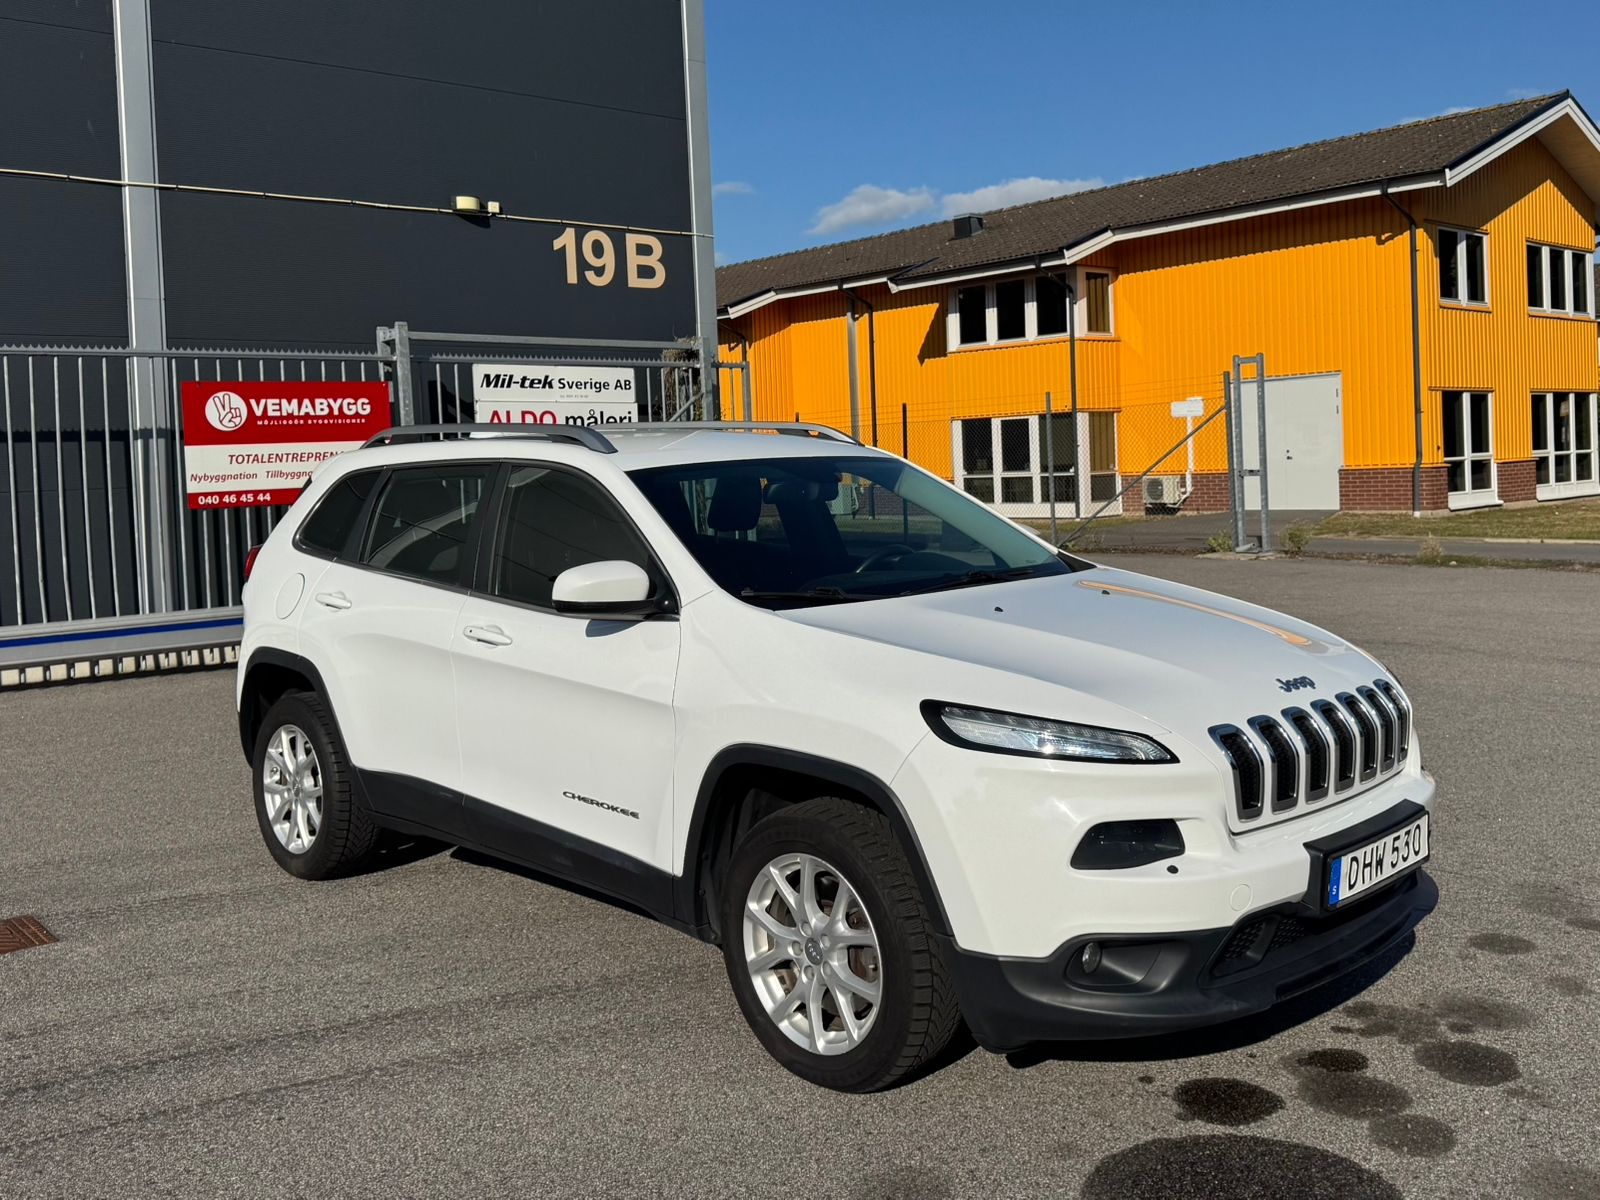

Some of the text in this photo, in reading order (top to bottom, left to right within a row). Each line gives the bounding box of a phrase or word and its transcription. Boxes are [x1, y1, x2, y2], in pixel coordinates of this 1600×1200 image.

[552, 227, 666, 289] 19 B
[480, 373, 632, 393] Mil-tek Sverige AB
[249, 397, 372, 417] VEMABYGG
[564, 408, 632, 427] måleri
[228, 450, 344, 465] TOTALENTREPREN
[190, 471, 258, 483] Nybyggnation
[198, 492, 271, 505] 040 46 45 44
[1275, 675, 1317, 693] Jeep
[562, 790, 640, 820] CHEROKEE
[1347, 823, 1421, 891] DHW 530
[1331, 885, 1338, 896] S
